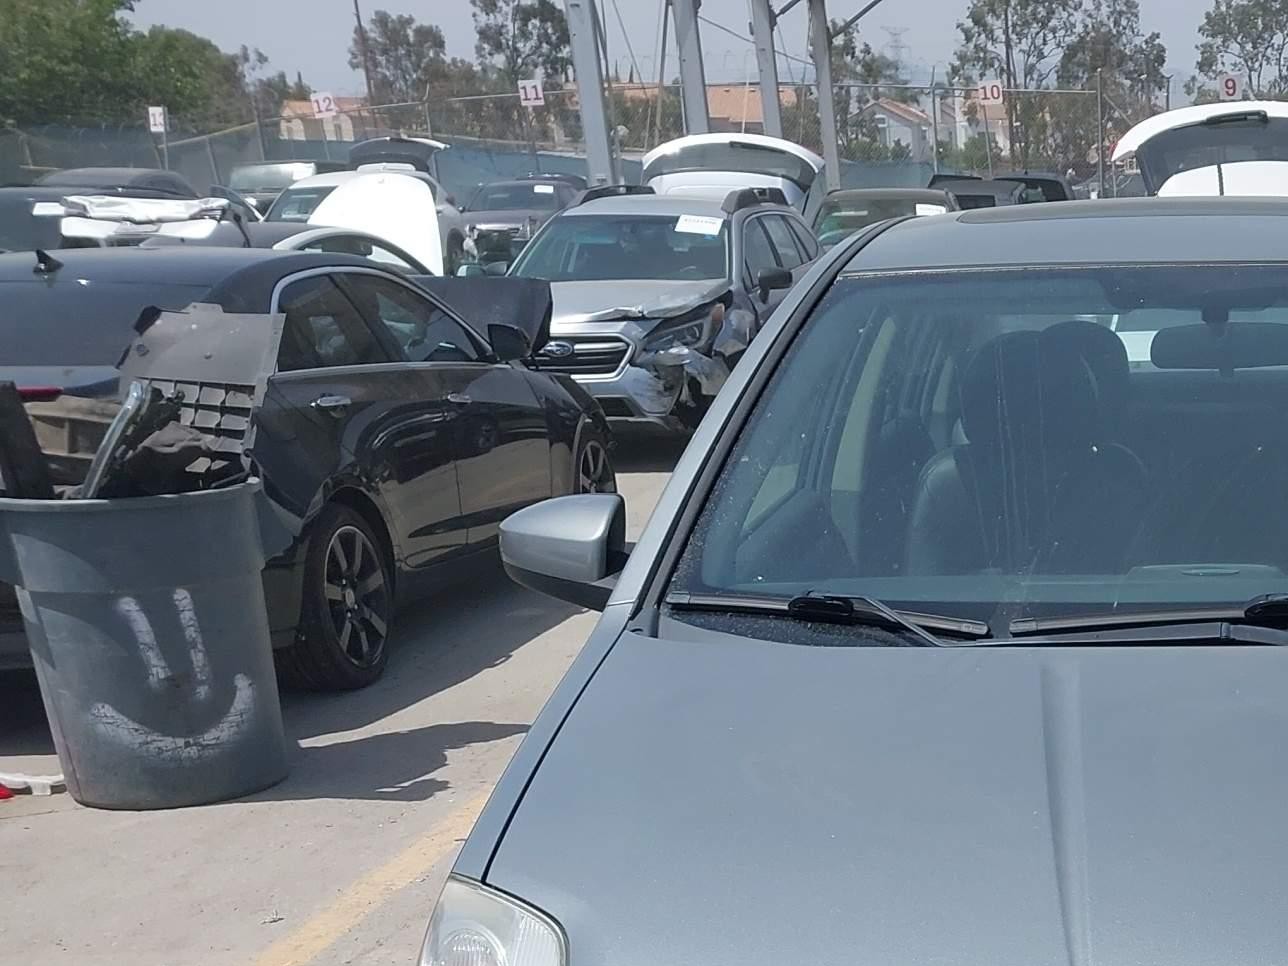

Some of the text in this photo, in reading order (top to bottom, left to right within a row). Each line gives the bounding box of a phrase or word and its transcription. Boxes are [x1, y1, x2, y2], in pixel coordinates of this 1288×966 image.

[520, 84, 542, 101] 11
[979, 84, 1001, 100] 10
[1224, 78, 1236, 97] 9
[314, 96, 333, 113] 12
